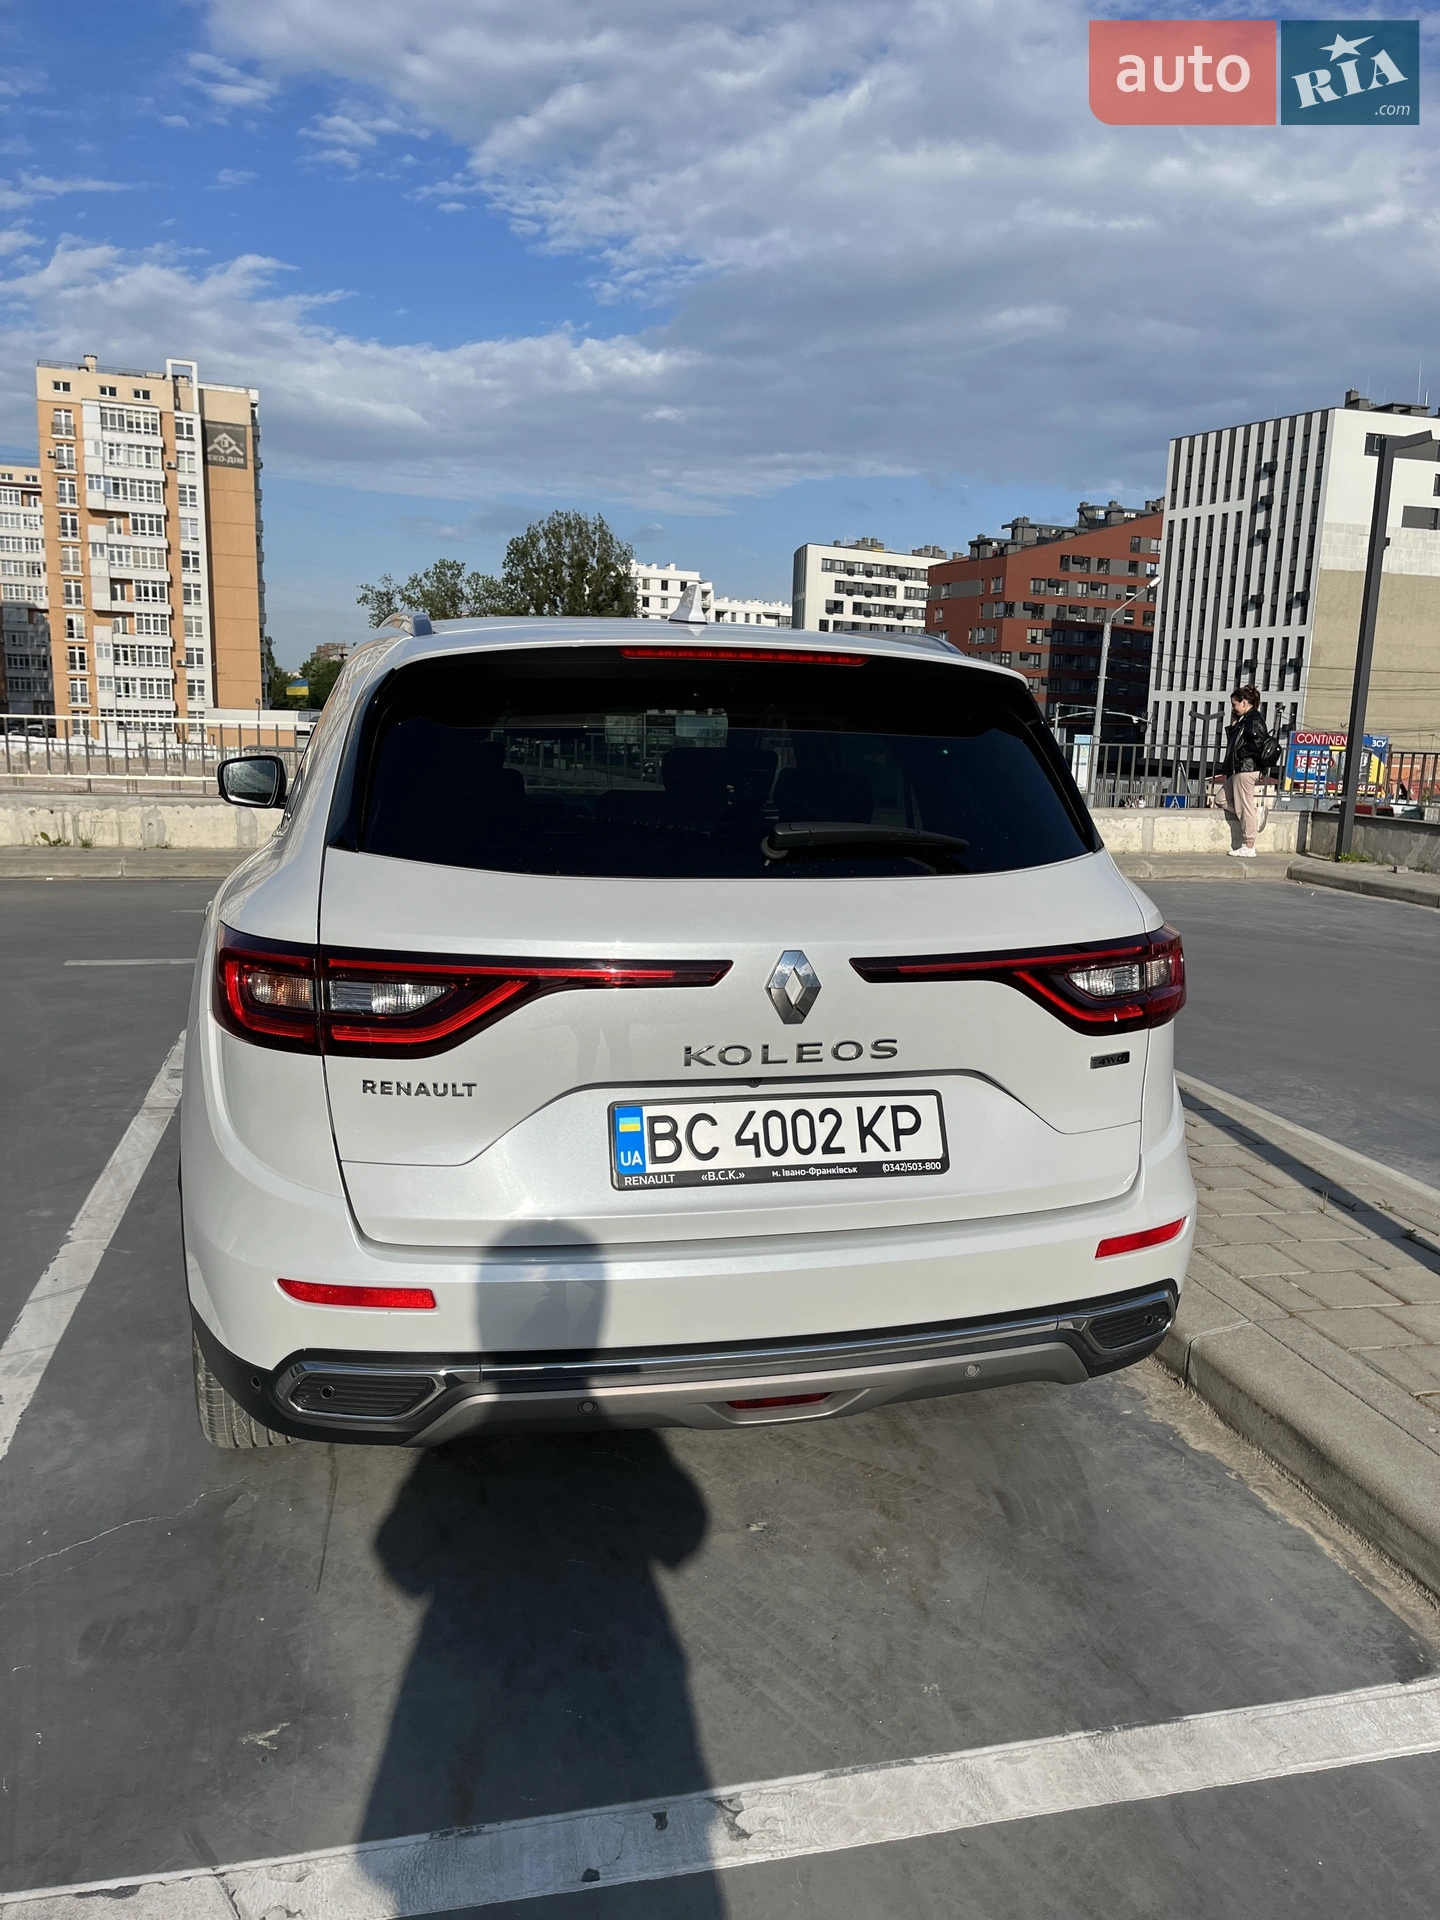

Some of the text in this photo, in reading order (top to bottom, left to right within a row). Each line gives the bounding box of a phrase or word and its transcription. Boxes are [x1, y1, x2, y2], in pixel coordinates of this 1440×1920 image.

[207, 454, 244, 464] ЕКО-ДІМ
[1296, 733, 1347, 745] CONTINEN
[683, 1038, 898, 1067] KOLEOS
[361, 1079, 478, 1097] RENAULT
[646, 1104, 922, 1164] BC 4002 KP
[620, 1150, 643, 1167] UA
[782, 1166, 858, 1177] Івано-Франківськ
[882, 1161, 942, 1173] (0342)503-800
[624, 1174, 676, 1186] RENAULT
